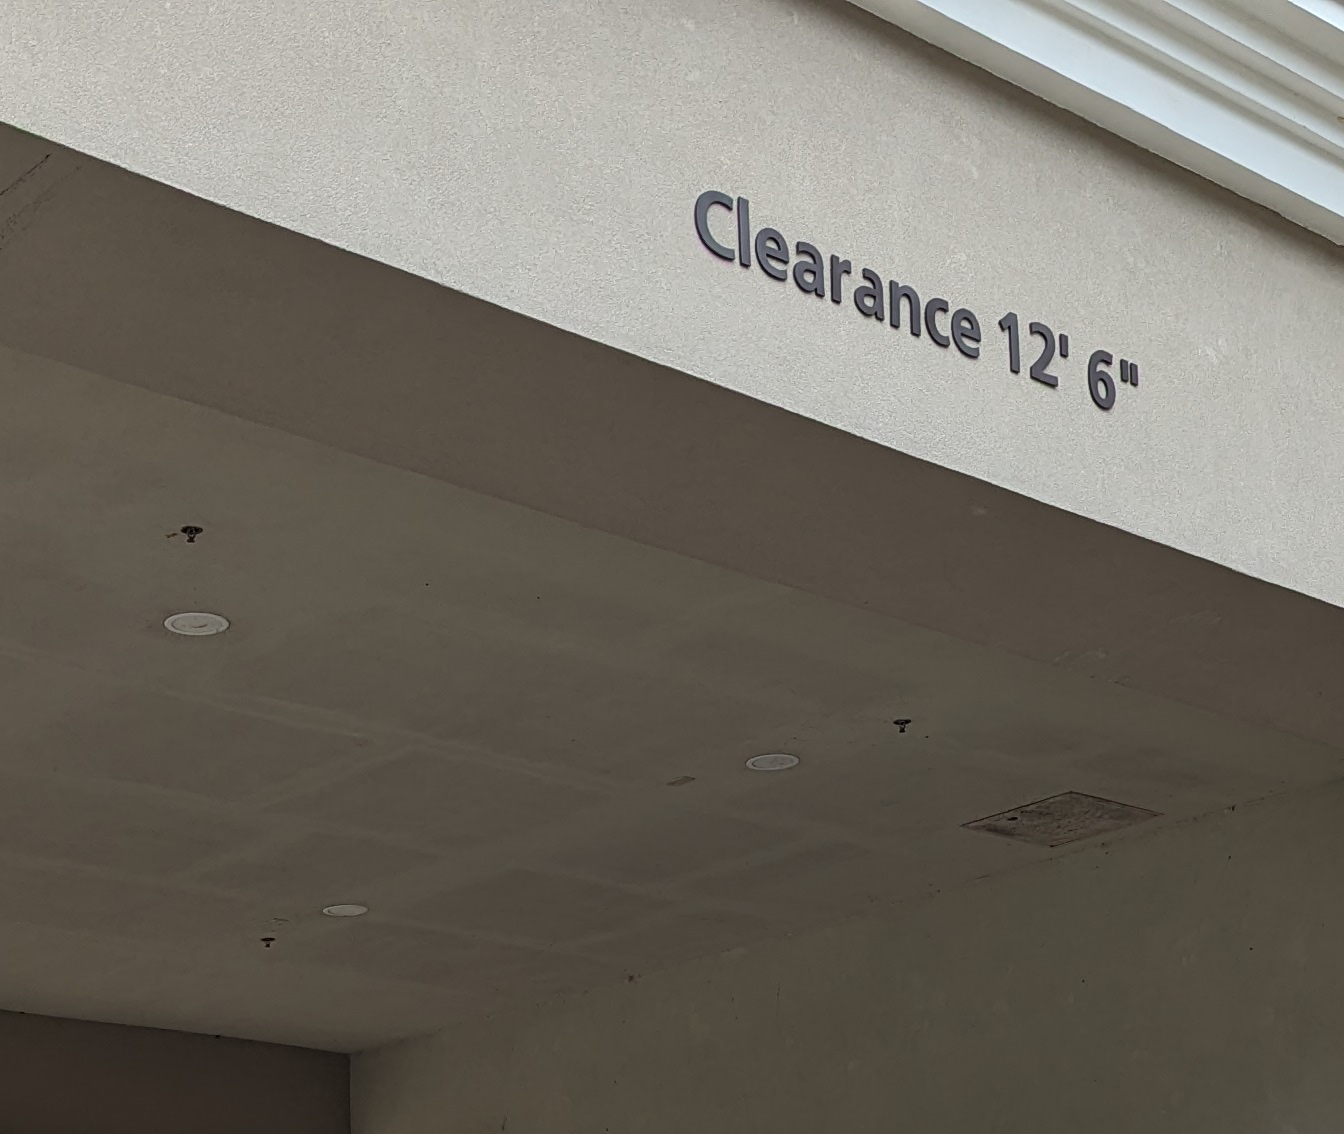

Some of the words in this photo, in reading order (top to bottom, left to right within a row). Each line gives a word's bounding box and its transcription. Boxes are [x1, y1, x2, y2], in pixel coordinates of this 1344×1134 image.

[694, 190, 982, 359] Clearance
[998, 311, 1069, 387] 12'
[1087, 349, 1139, 410] 6"
